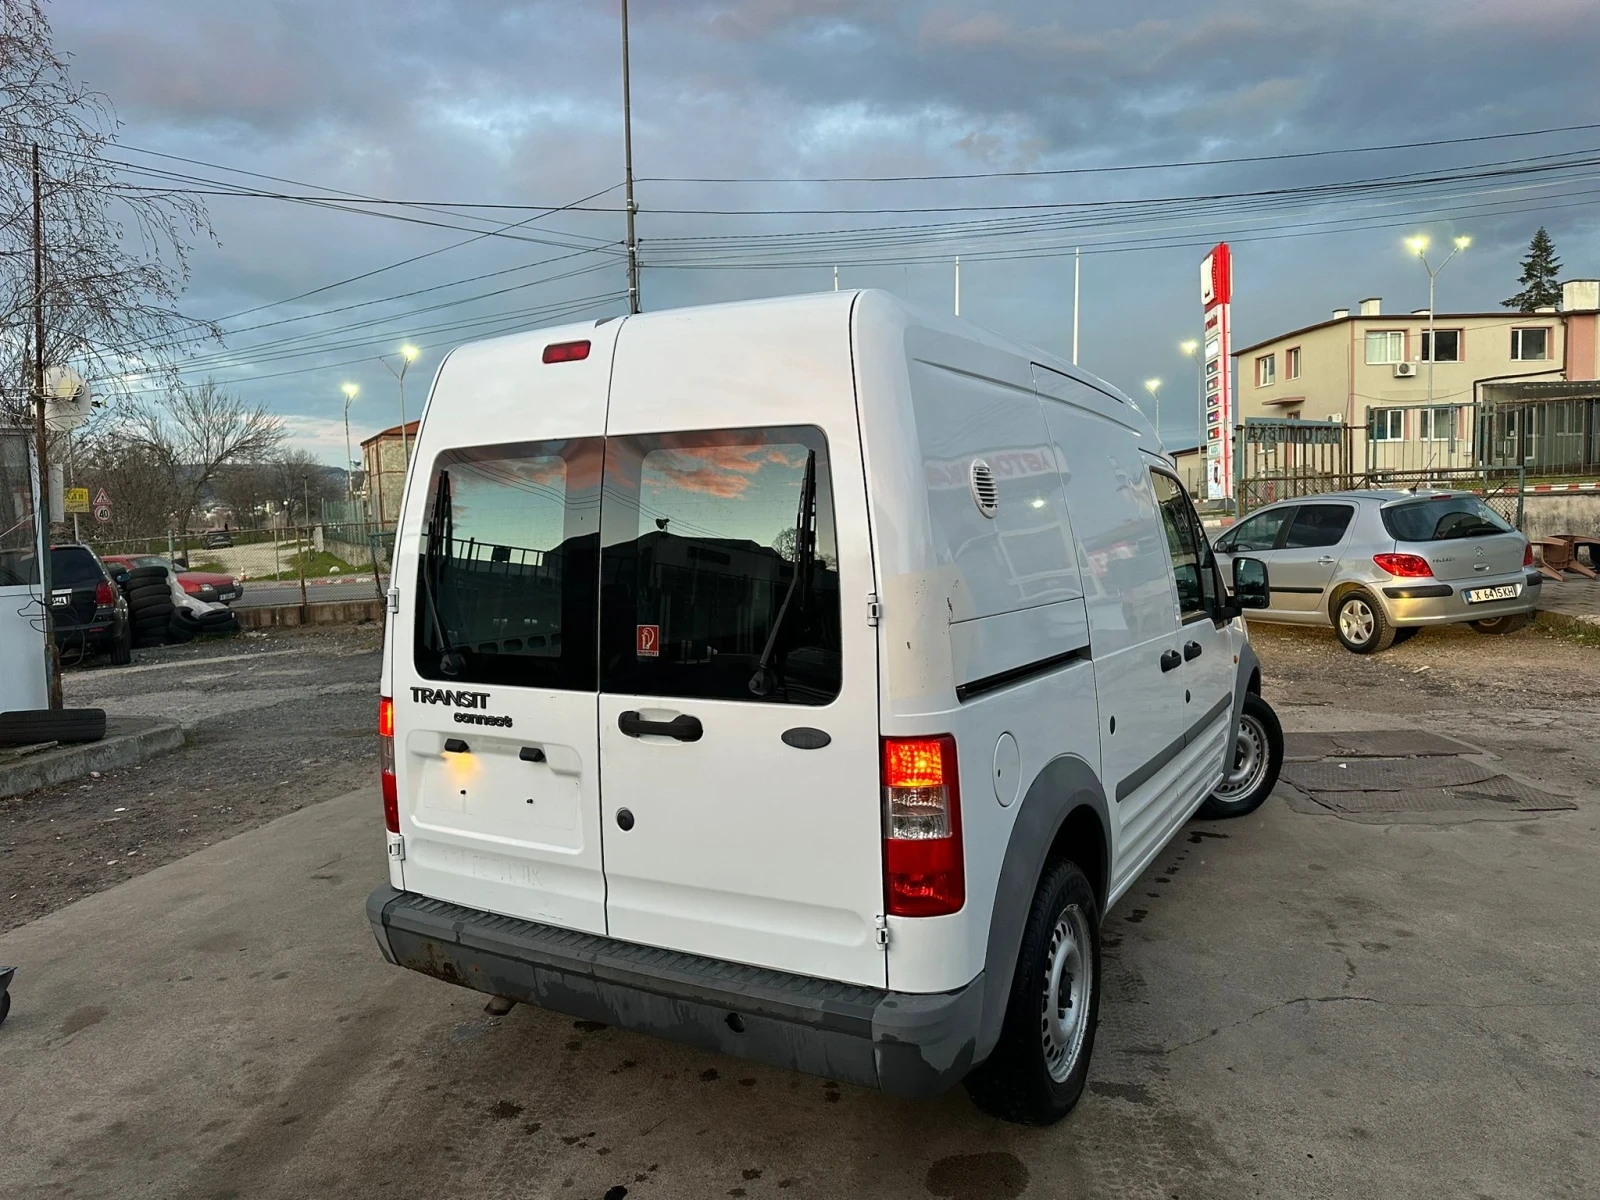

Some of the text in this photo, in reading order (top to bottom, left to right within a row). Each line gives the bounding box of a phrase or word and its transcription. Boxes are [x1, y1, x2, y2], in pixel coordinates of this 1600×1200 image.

[99, 510, 109, 518] 40
[410, 687, 491, 709] TRANSIT
[454, 712, 513, 728] connect
